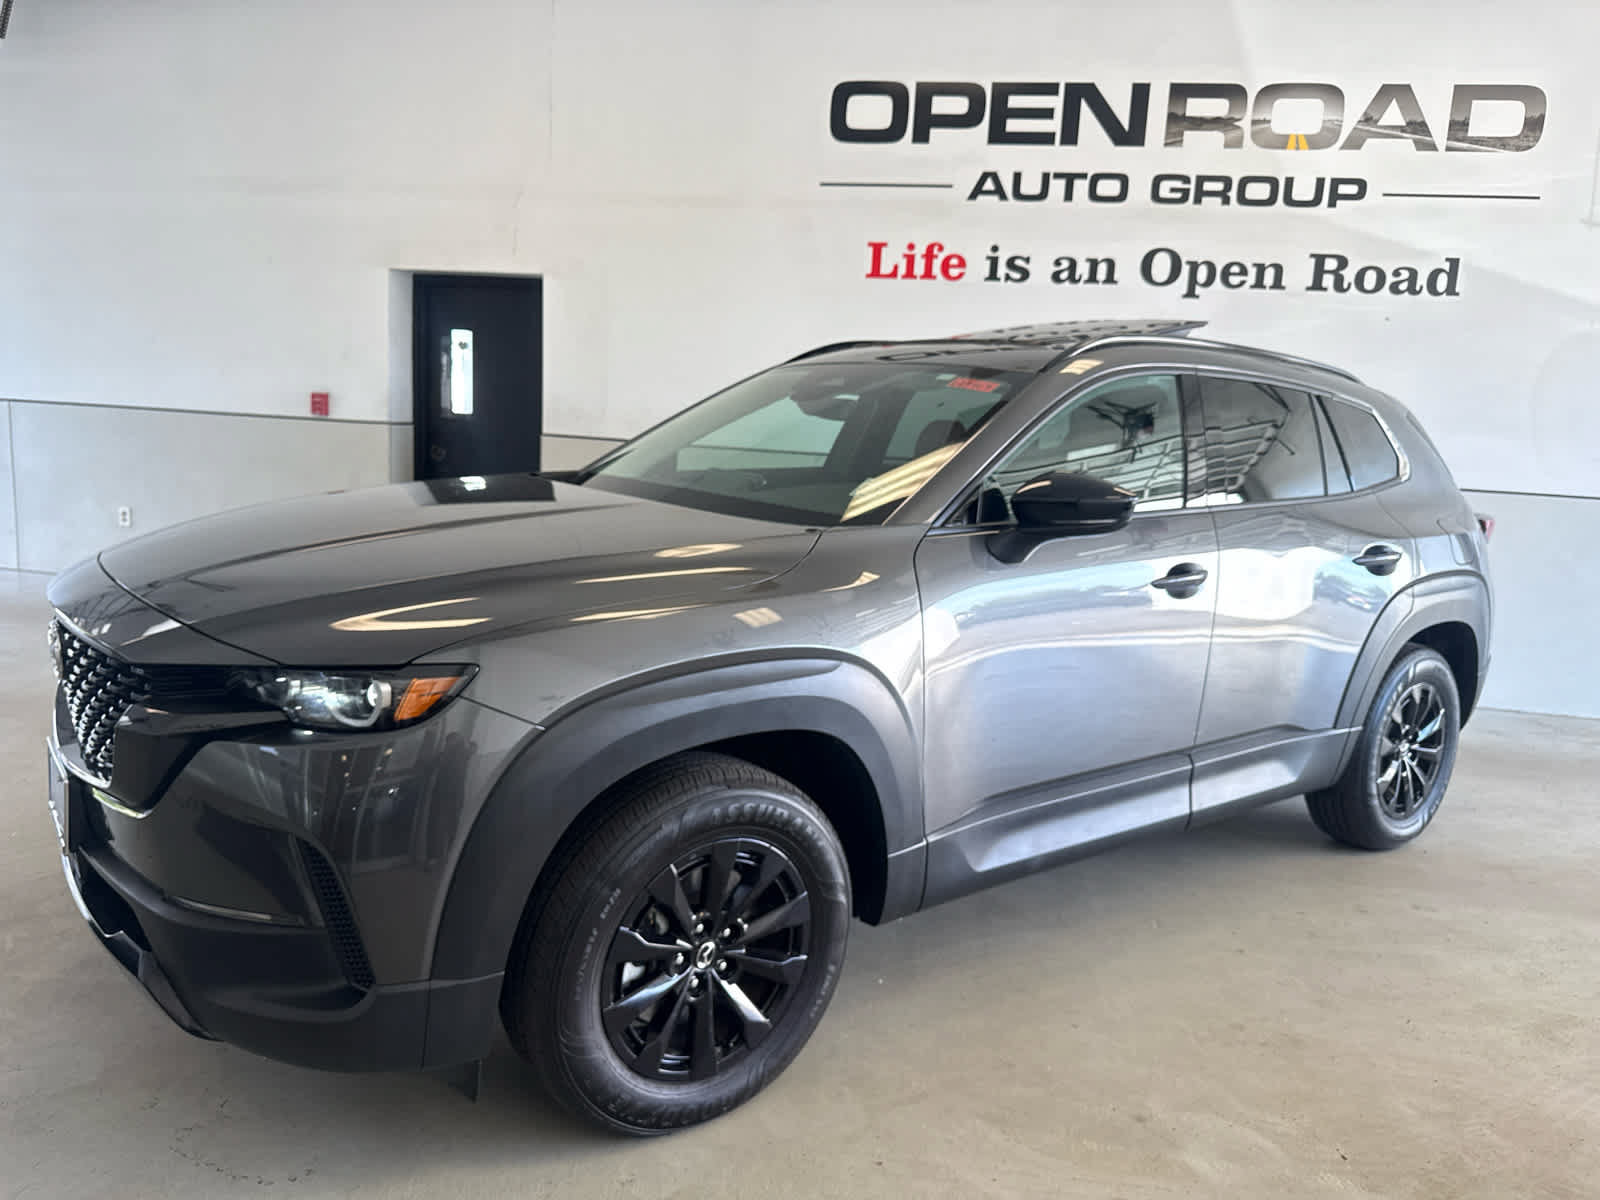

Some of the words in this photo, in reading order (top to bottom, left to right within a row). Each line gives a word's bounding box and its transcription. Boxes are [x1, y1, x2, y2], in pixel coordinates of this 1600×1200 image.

[829, 81, 1151, 147] OPEN
[1163, 82, 1548, 152] ROAD
[967, 172, 1129, 203] AUTO
[1150, 174, 1368, 208] GROUP
[866, 242, 967, 282] Life
[984, 245, 1031, 283] is
[1050, 257, 1118, 285] an
[1140, 247, 1286, 299] Open
[1306, 253, 1461, 297] Road
